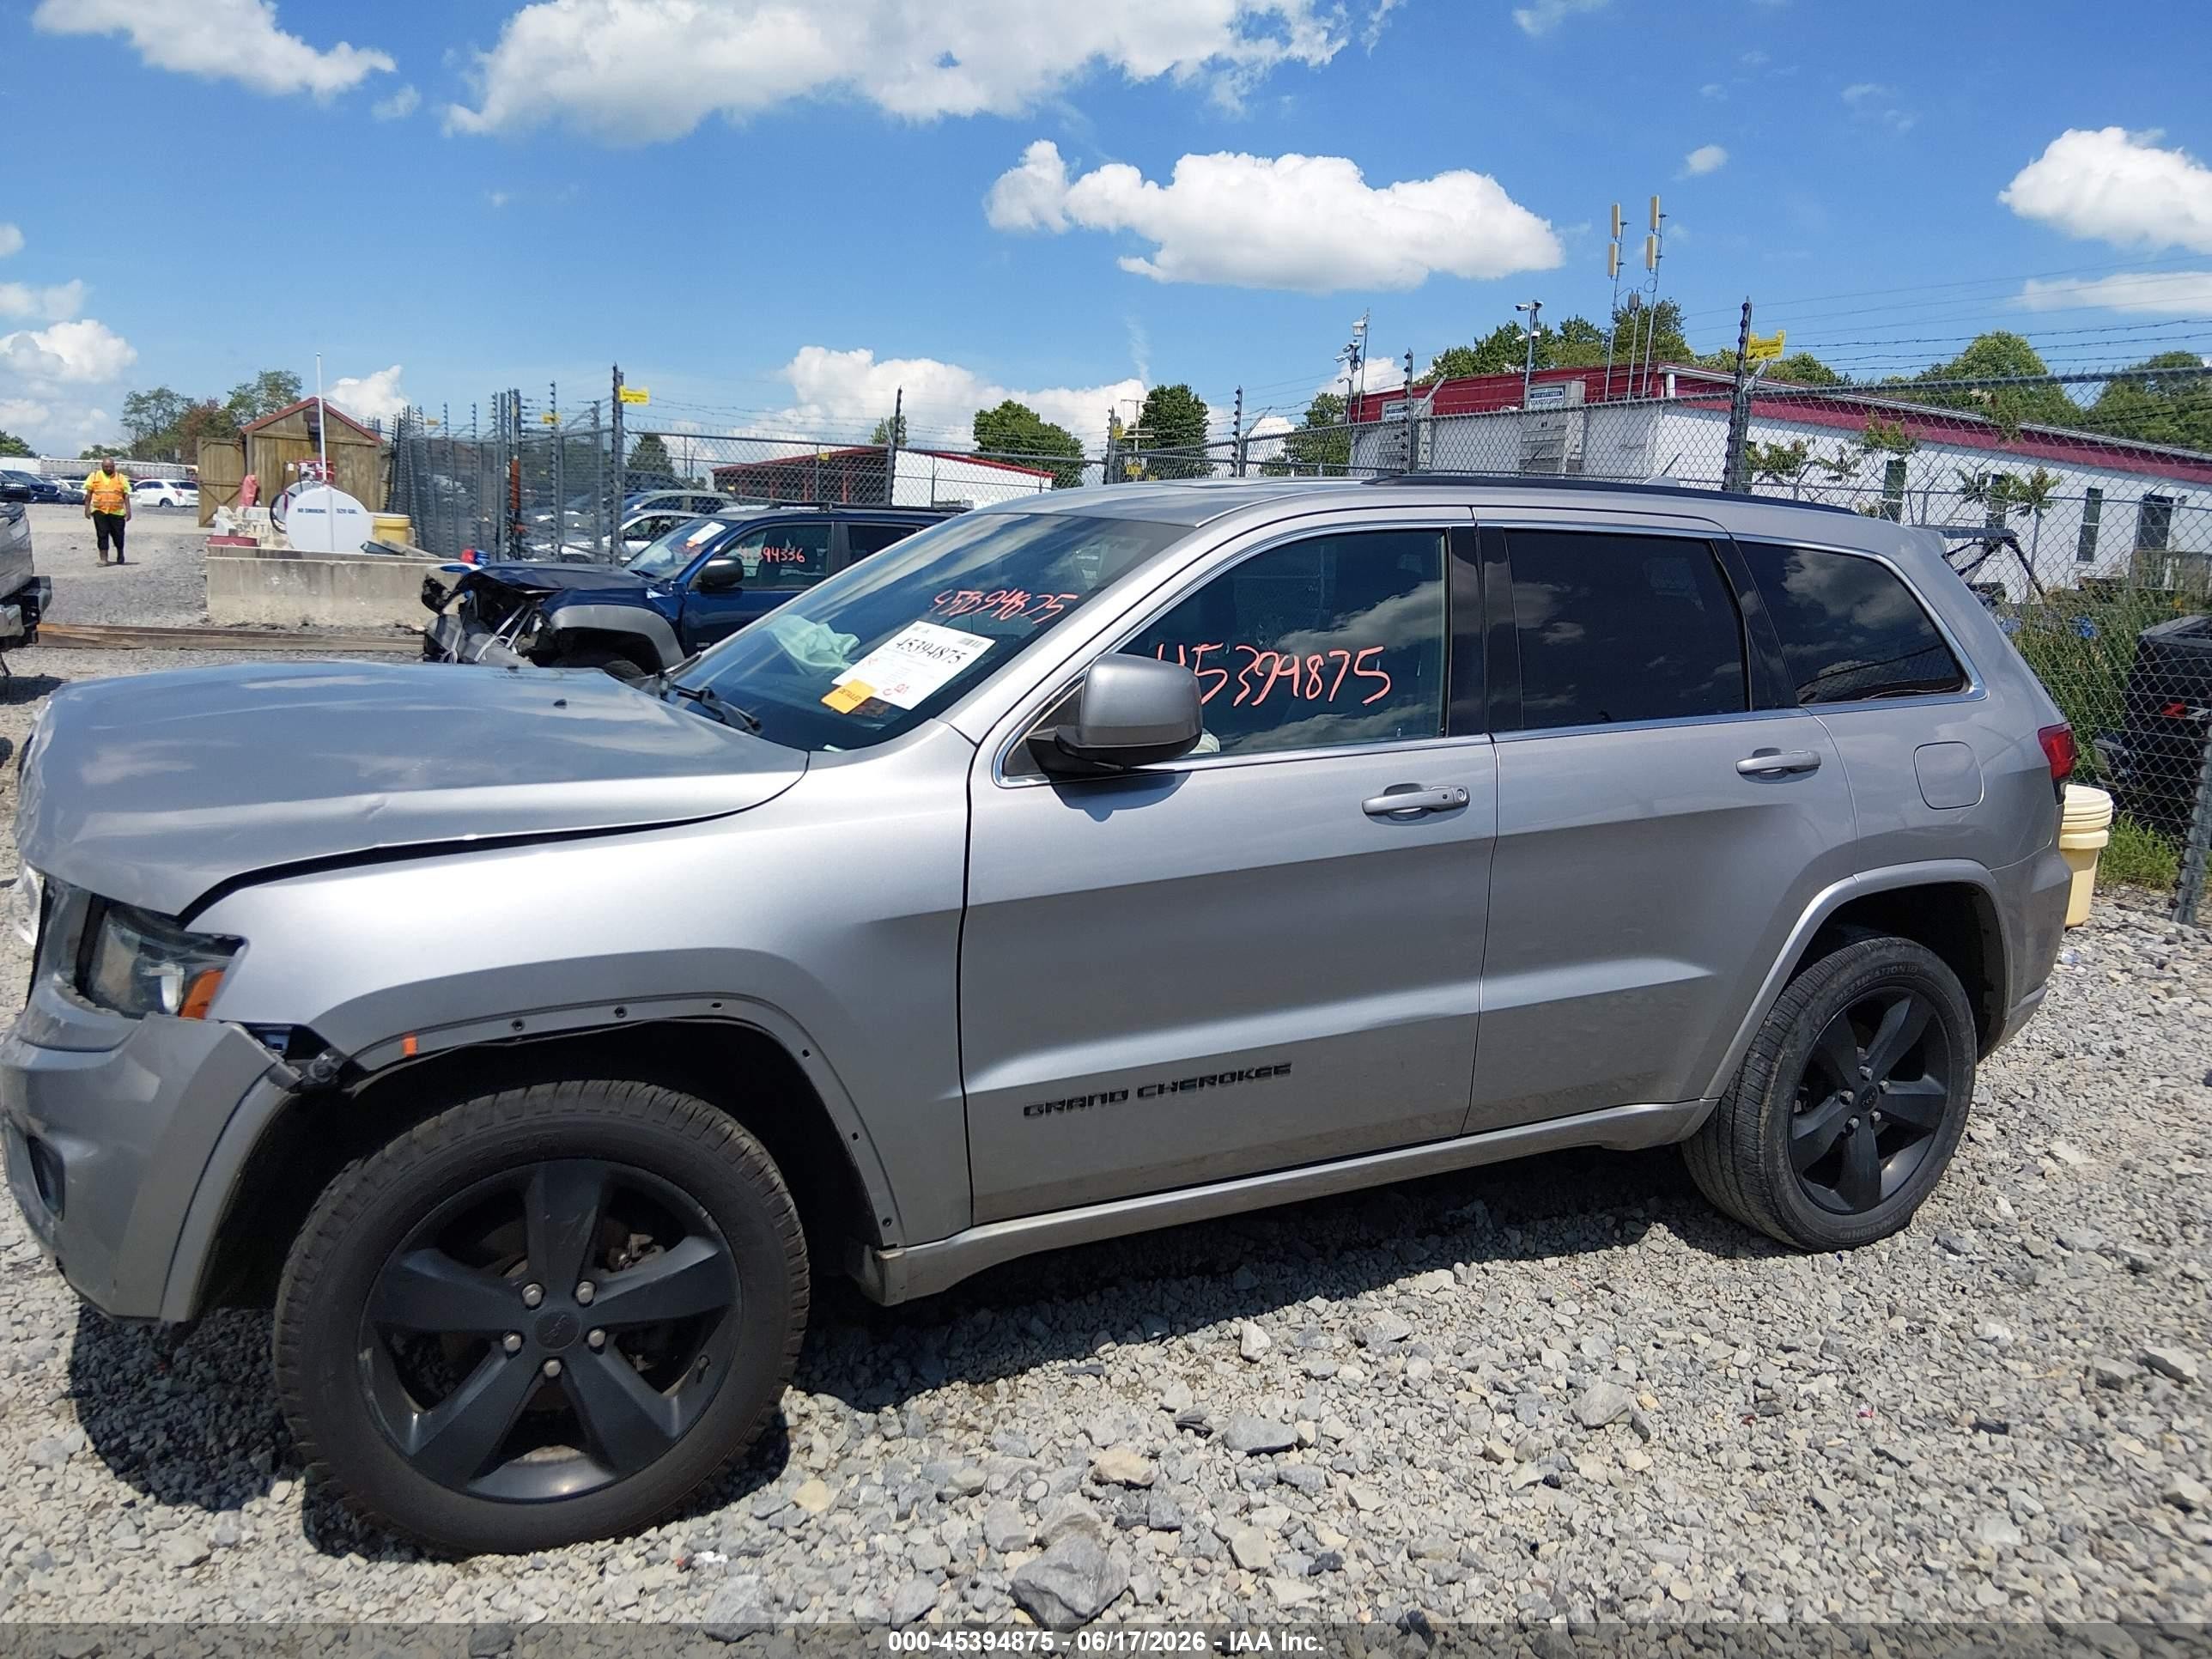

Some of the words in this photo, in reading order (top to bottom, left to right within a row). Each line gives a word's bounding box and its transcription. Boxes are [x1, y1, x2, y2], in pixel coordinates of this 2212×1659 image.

[896, 636, 969, 665] 45394875
[1023, 1089, 1128, 1117] GRAND
[1137, 1062, 1291, 1099] CHEROKEE
